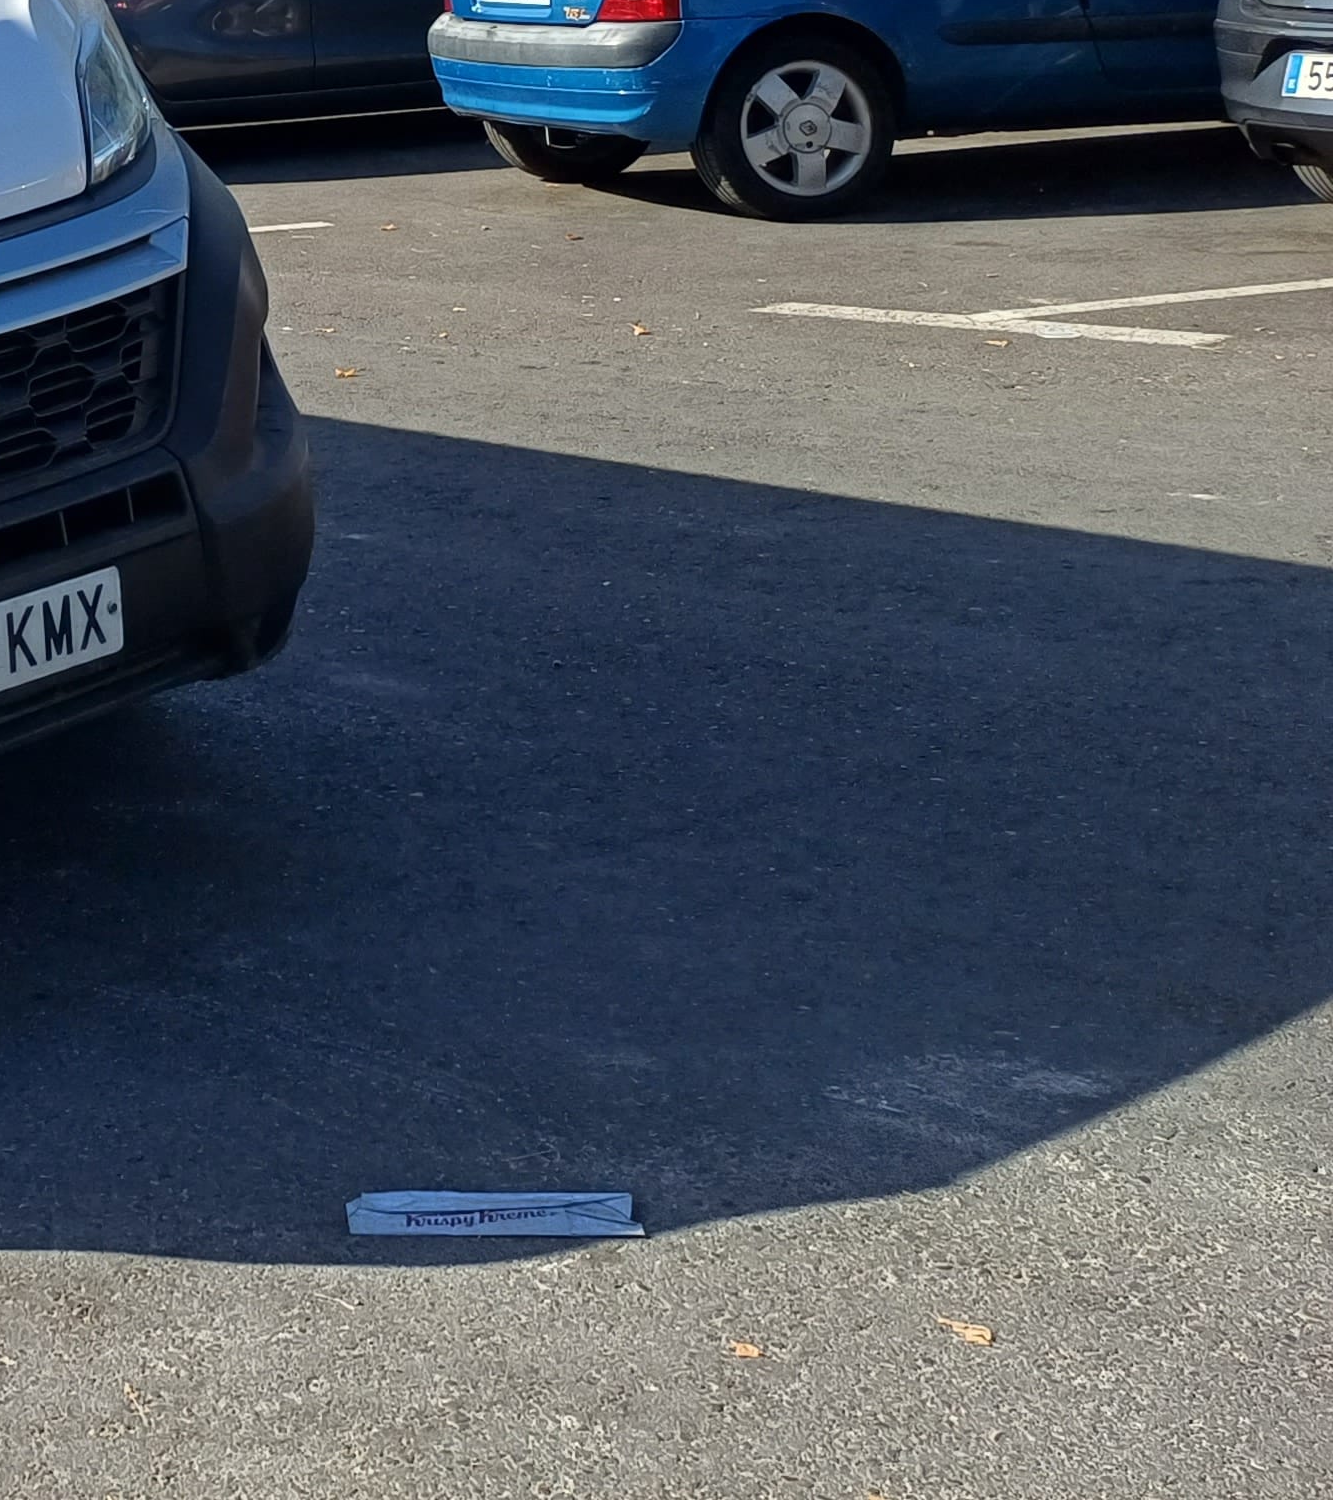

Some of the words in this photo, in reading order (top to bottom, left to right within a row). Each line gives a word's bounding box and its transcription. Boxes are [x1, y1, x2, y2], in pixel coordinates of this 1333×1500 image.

[6, 583, 107, 673] KMX
[405, 1212, 475, 1227] Krispy
[478, 1208, 546, 1224] Kreme
